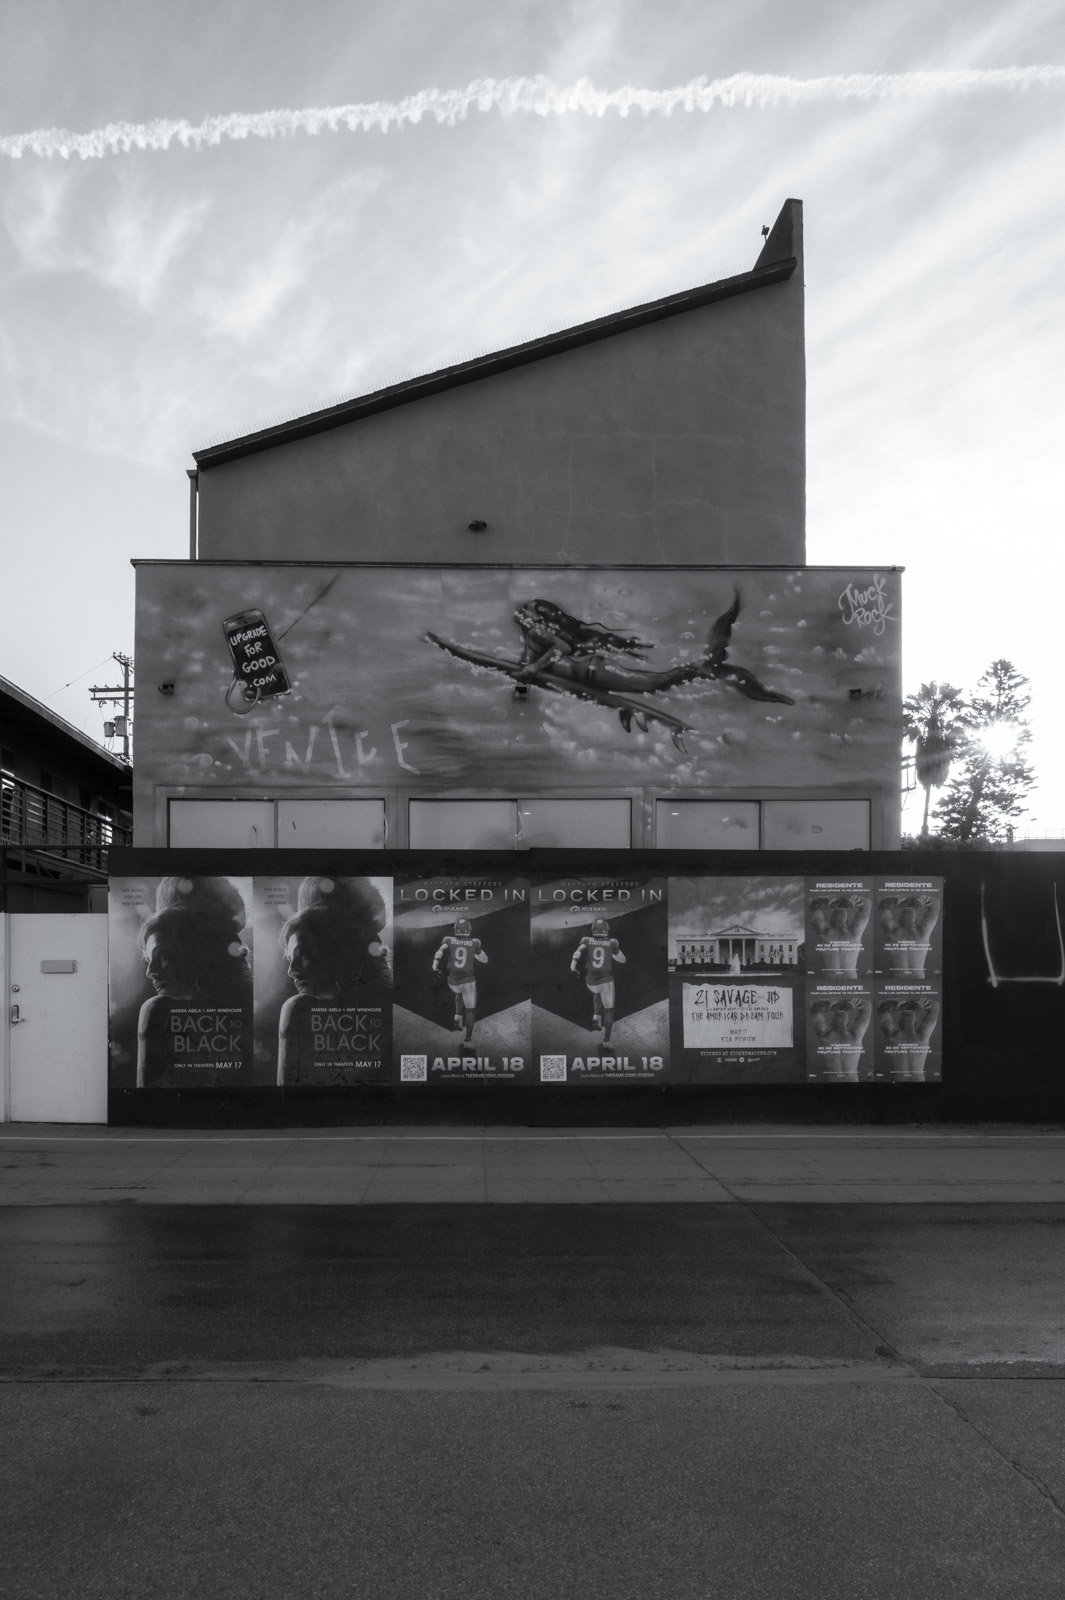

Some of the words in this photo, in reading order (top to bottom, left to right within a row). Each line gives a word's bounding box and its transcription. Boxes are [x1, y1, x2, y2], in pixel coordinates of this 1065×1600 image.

[229, 625, 268, 646] UPGRADE
[242, 656, 276, 673] GOOD
[249, 674, 277, 688] .COM
[400, 888, 493, 901] LOCKED
[504, 889, 525, 901] IN
[538, 889, 631, 902] LOCKED
[641, 889, 662, 902] IN
[454, 946, 468, 969] 9
[592, 946, 606, 969] 9
[694, 989, 708, 1008] 21
[713, 988, 757, 1007] SAVAGE
[170, 1015, 228, 1033] BACK
[229, 1019, 242, 1028] TO
[311, 1014, 368, 1032] BACK
[369, 1019, 382, 1028] TO
[691, 1012, 703, 1021] THE
[706, 1011, 737, 1021] AMERICAN
[740, 1012, 764, 1021] DREAM
[766, 1011, 786, 1020] TOUR
[174, 1034, 241, 1052] BLACK
[314, 1033, 381, 1051] BLACK
[215, 1061, 233, 1069] MAY
[234, 1061, 242, 1069] 17
[355, 1060, 372, 1068] MAY
[373, 1060, 382, 1068] 17
[431, 1057, 497, 1071] APRIL
[502, 1056, 525, 1071] 18
[570, 1056, 636, 1071] APRIL
[641, 1056, 664, 1071] 18
